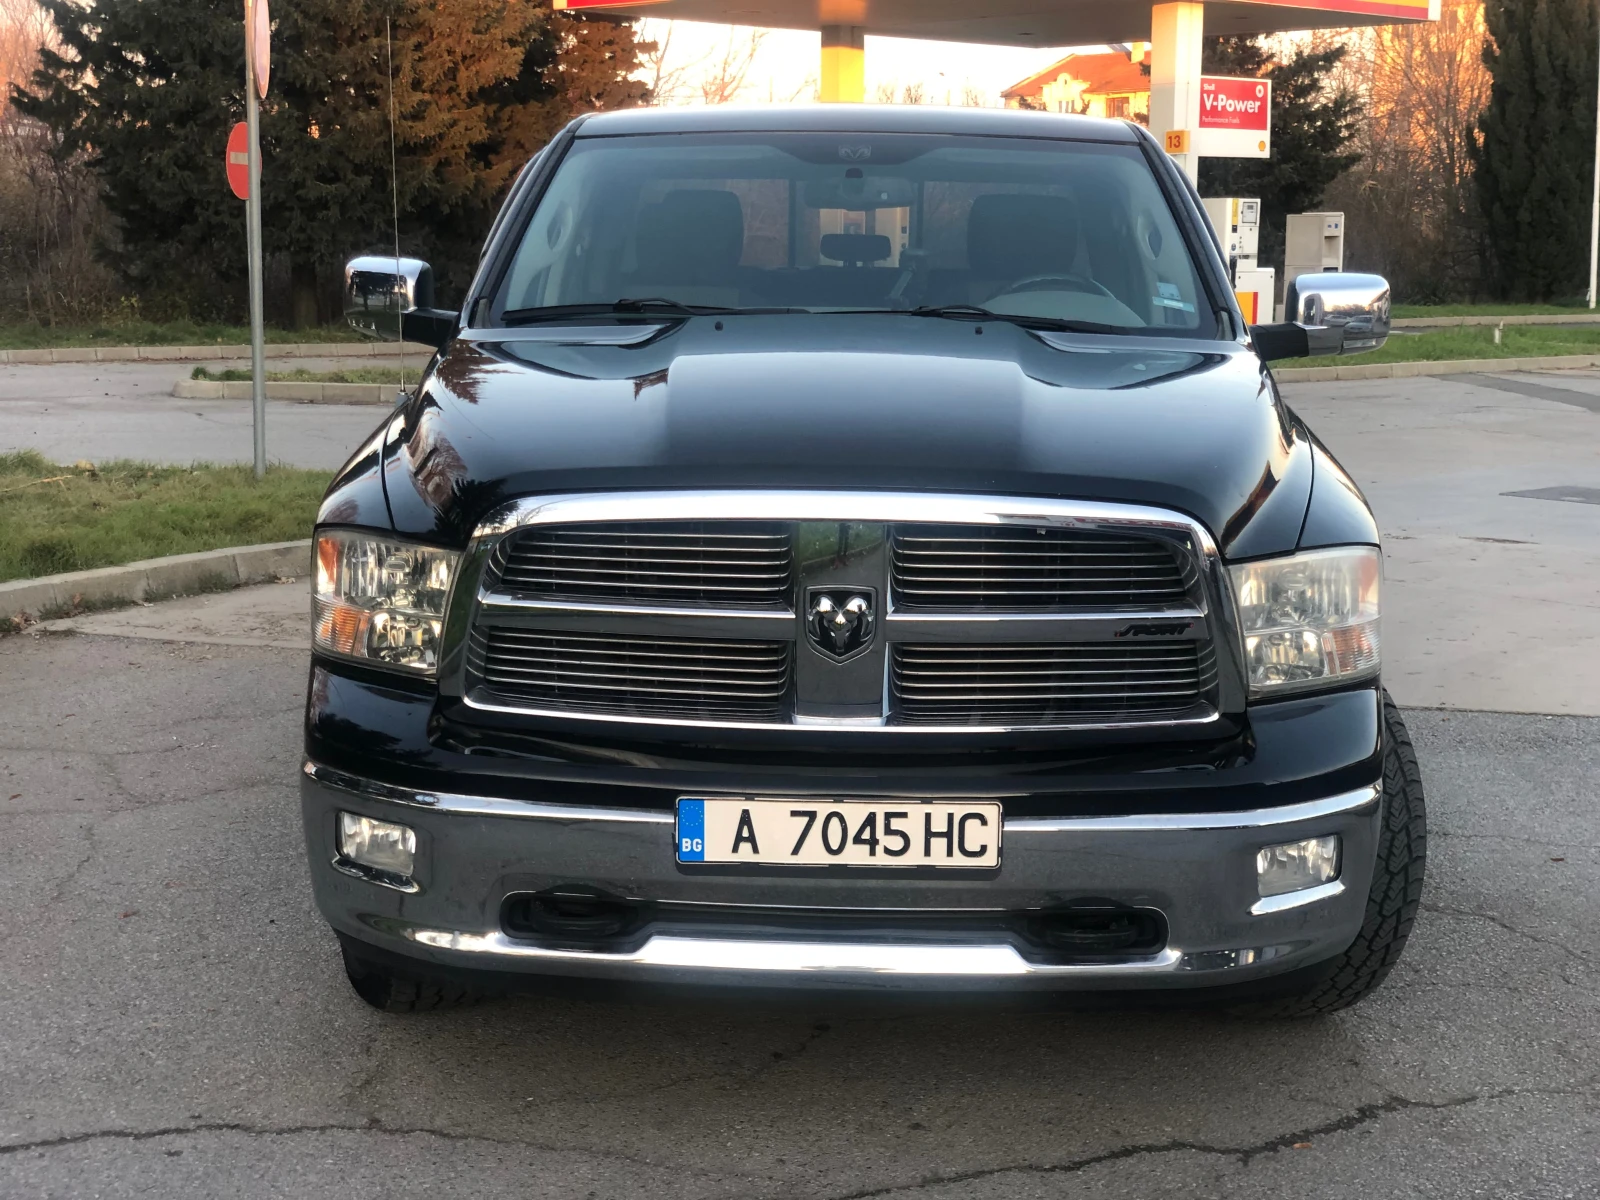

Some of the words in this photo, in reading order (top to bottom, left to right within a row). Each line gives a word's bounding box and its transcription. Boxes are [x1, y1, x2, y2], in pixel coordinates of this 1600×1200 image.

[1203, 93, 1261, 113] V-Power
[1168, 135, 1181, 149] 13
[731, 808, 760, 855] A
[790, 810, 911, 857] 7045
[924, 812, 989, 858] HC
[682, 838, 702, 852] BG
